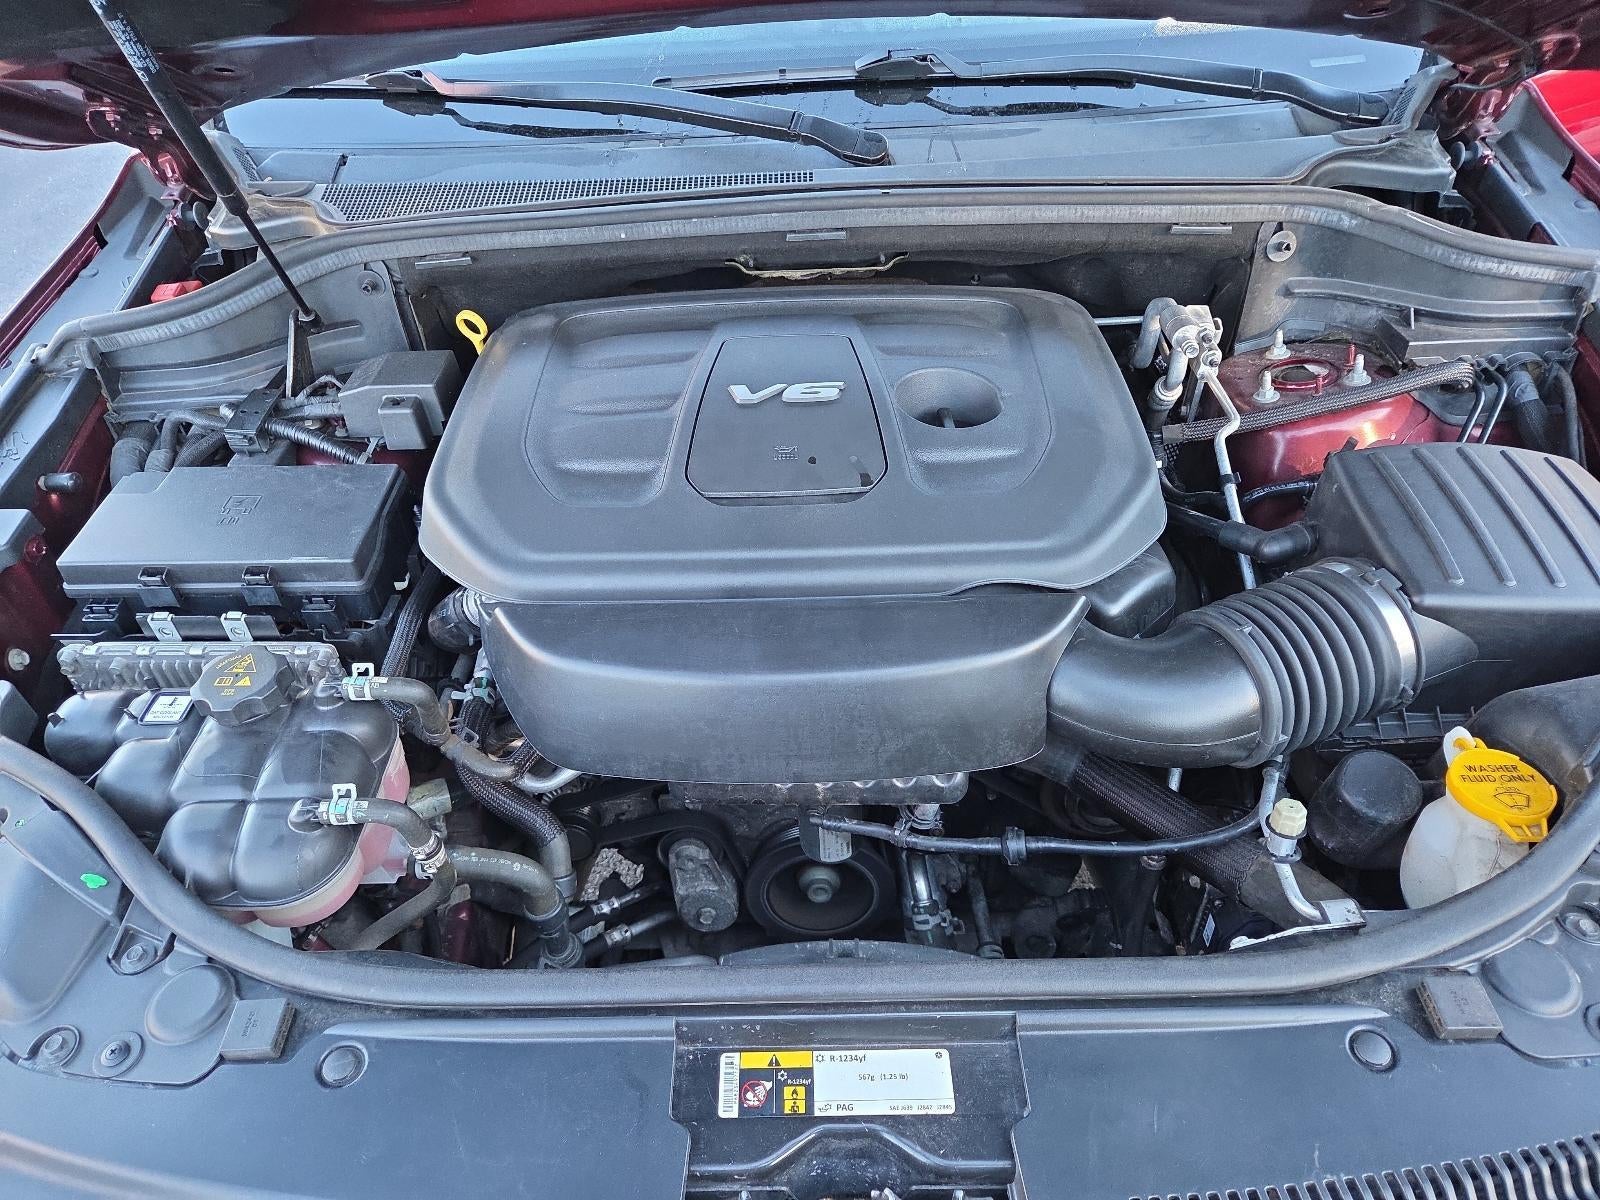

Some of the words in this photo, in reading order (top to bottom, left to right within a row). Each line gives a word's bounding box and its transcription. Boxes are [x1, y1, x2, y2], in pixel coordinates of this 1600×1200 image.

[727, 381, 847, 404] V6
[1464, 764, 1521, 773] WASHER
[1461, 774, 1497, 783] FLUID
[1500, 774, 1537, 783] ONLY
[829, 1054, 867, 1063] R-1234yf
[858, 1073, 875, 1082] 567g
[880, 1072, 898, 1081] (1.25
[899, 1072, 909, 1081] lb)
[787, 1078, 812, 1086] R-1234yf
[836, 1103, 854, 1112] PAG
